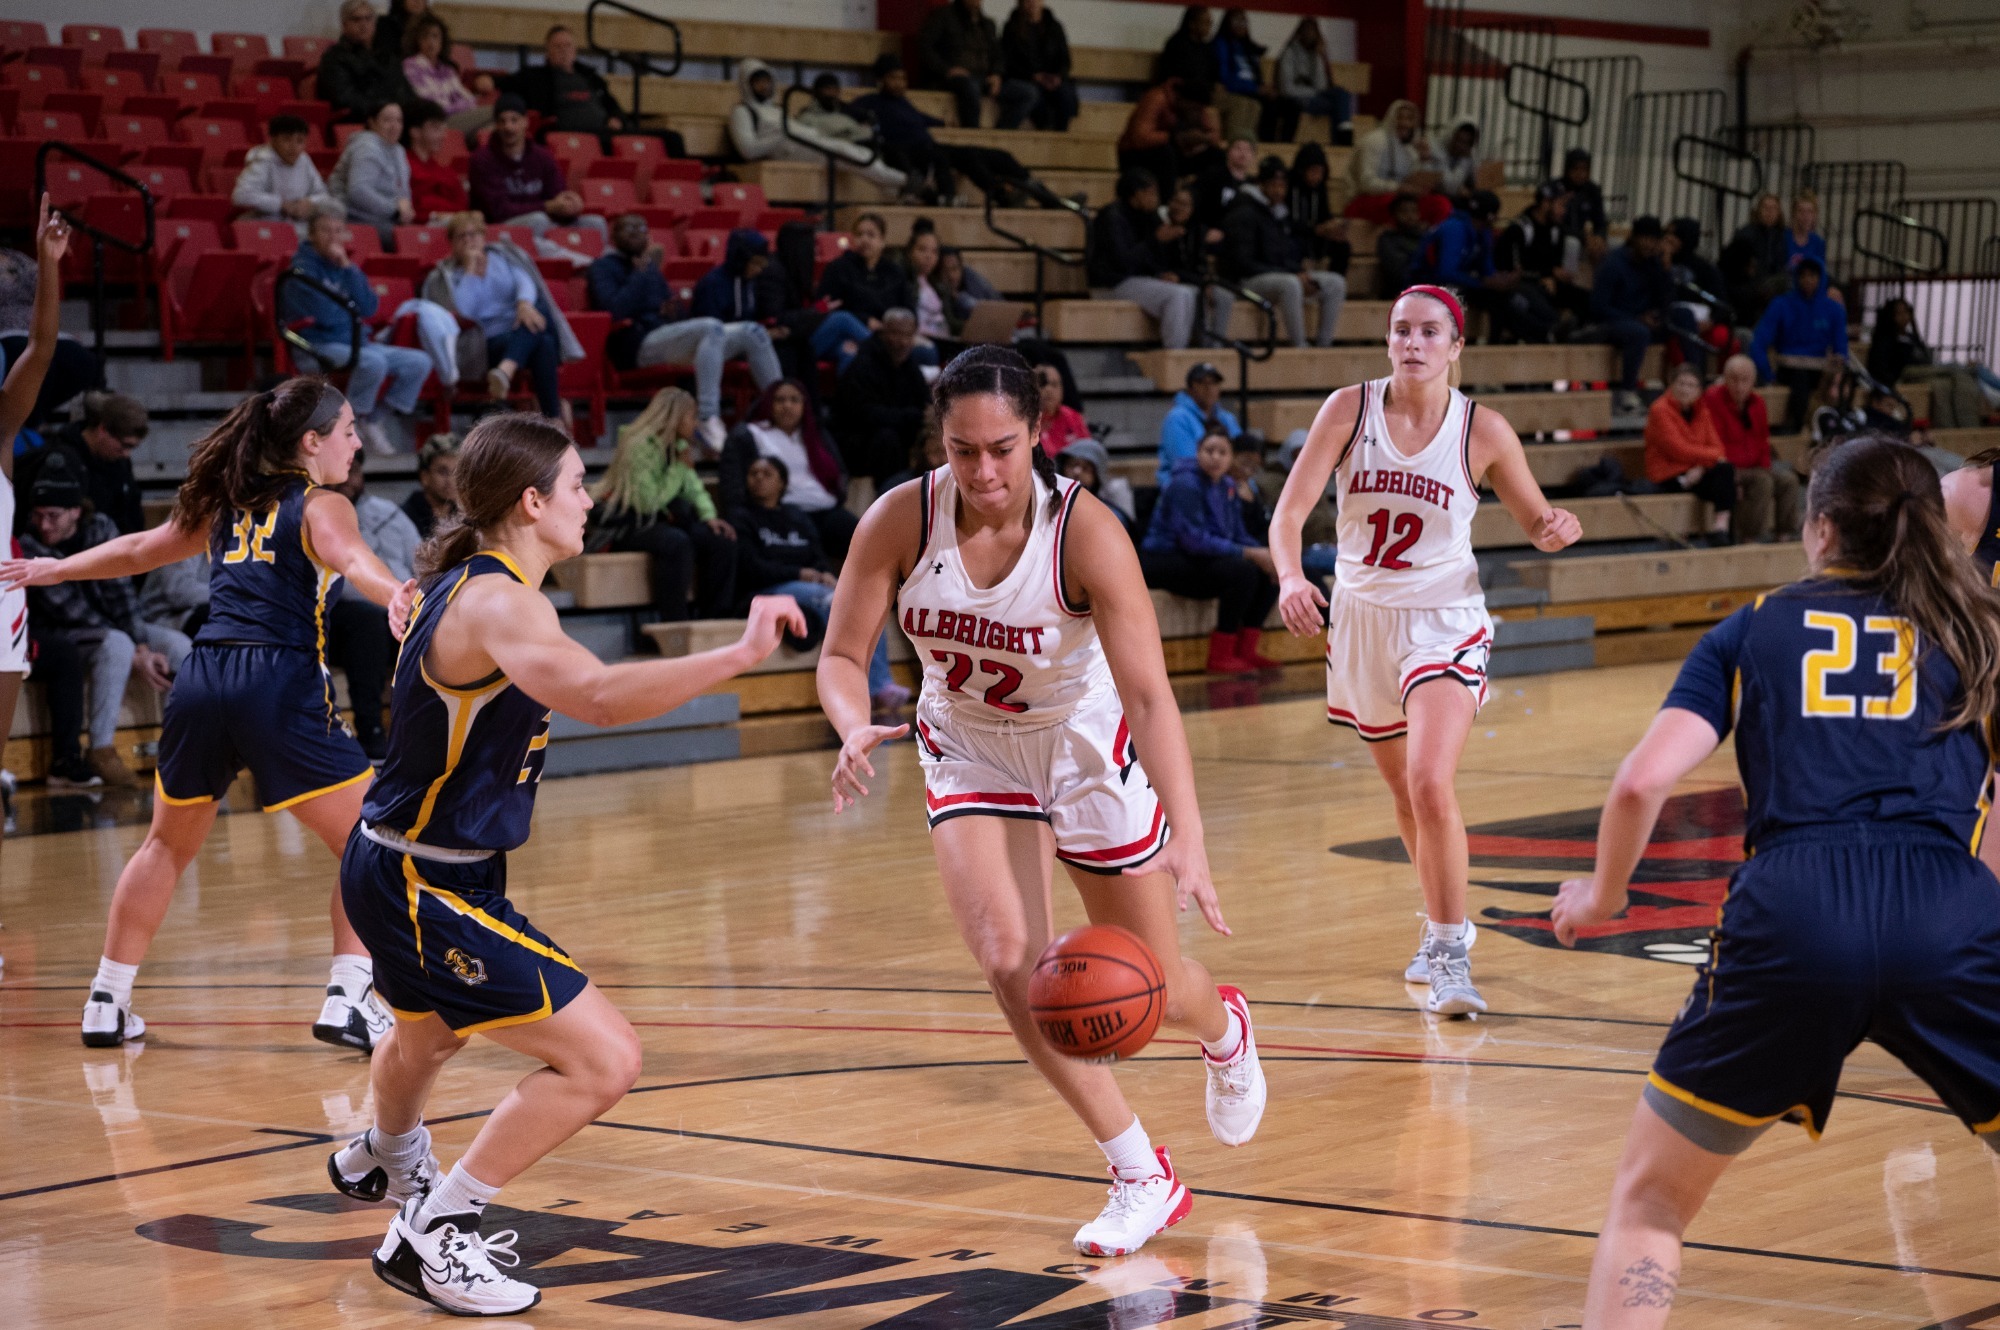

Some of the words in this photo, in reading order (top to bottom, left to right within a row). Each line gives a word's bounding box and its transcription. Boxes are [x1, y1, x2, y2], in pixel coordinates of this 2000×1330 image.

[1349, 469, 1454, 511] ALBRIGHT
[222, 500, 281, 565] 32
[1363, 508, 1423, 570] 12
[904, 607, 1044, 655] ALBRIGHT
[930, 649, 1029, 713] 22
[1801, 609, 1919, 720] 23
[1082, 1010, 1128, 1044] THE
